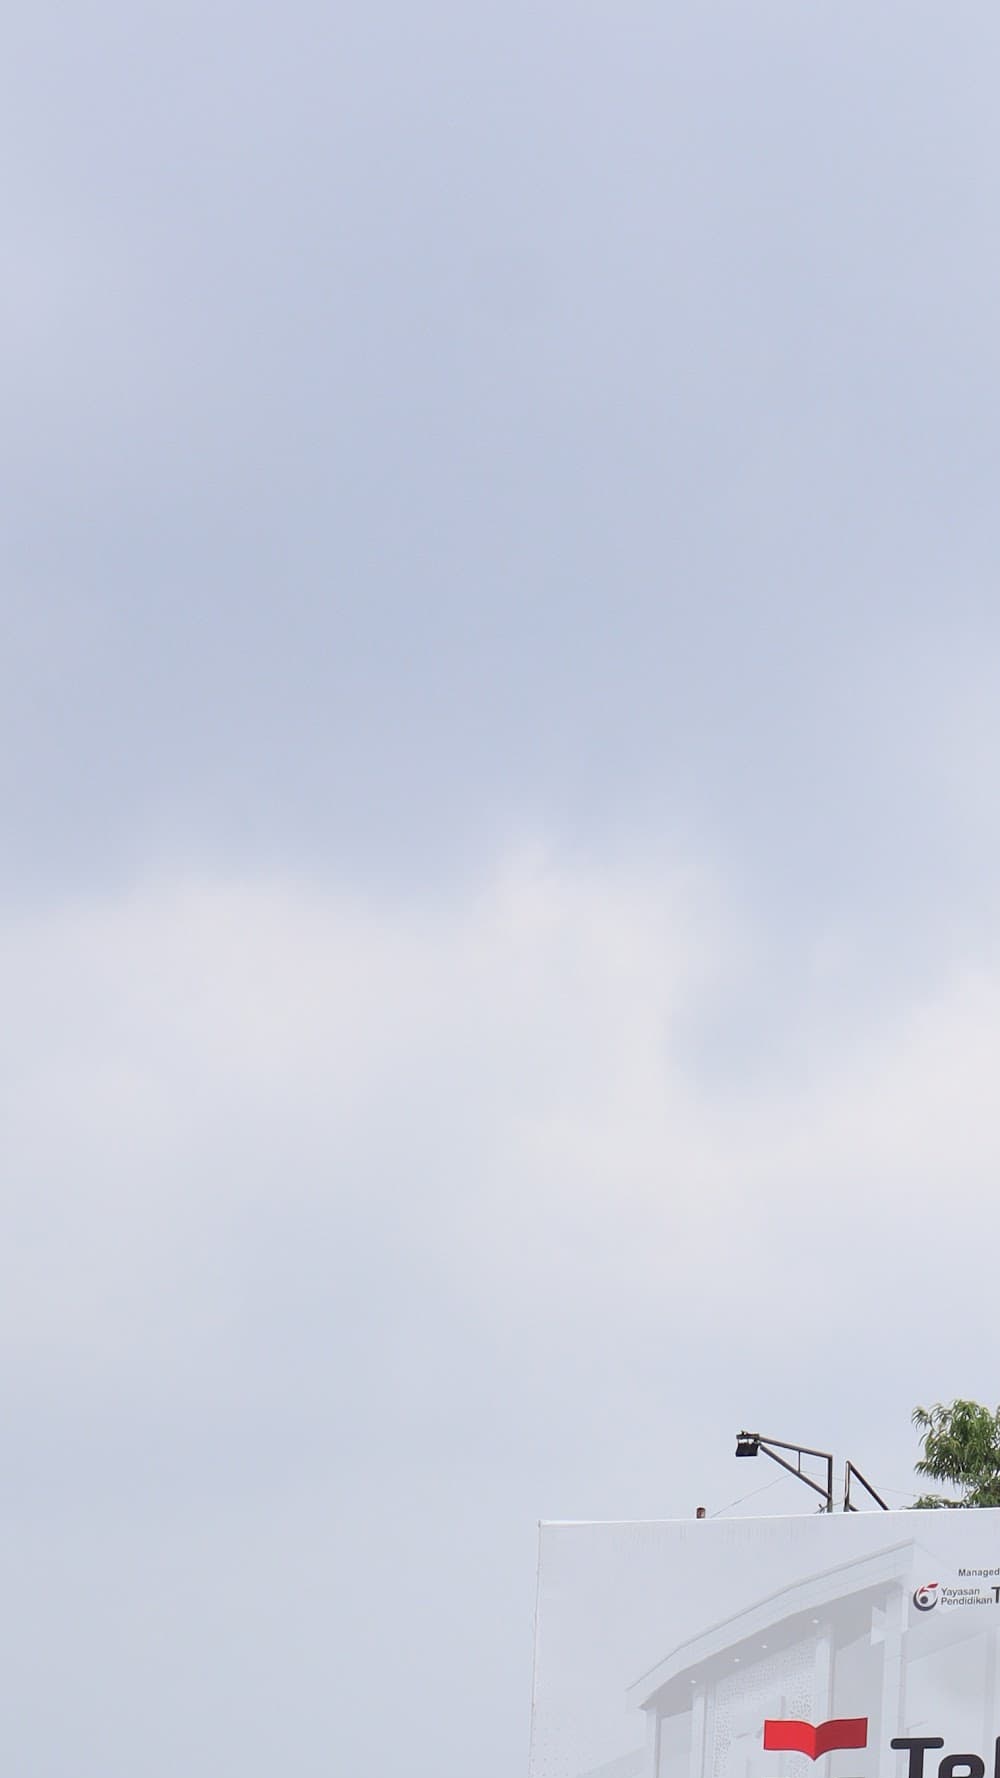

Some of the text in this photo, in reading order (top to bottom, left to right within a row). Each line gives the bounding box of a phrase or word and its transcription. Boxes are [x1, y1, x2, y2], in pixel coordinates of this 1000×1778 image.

[957, 1568, 1000, 1578] Managed
[941, 1588, 980, 1598] Yayasan
[940, 1597, 993, 1606] Pendidikan
